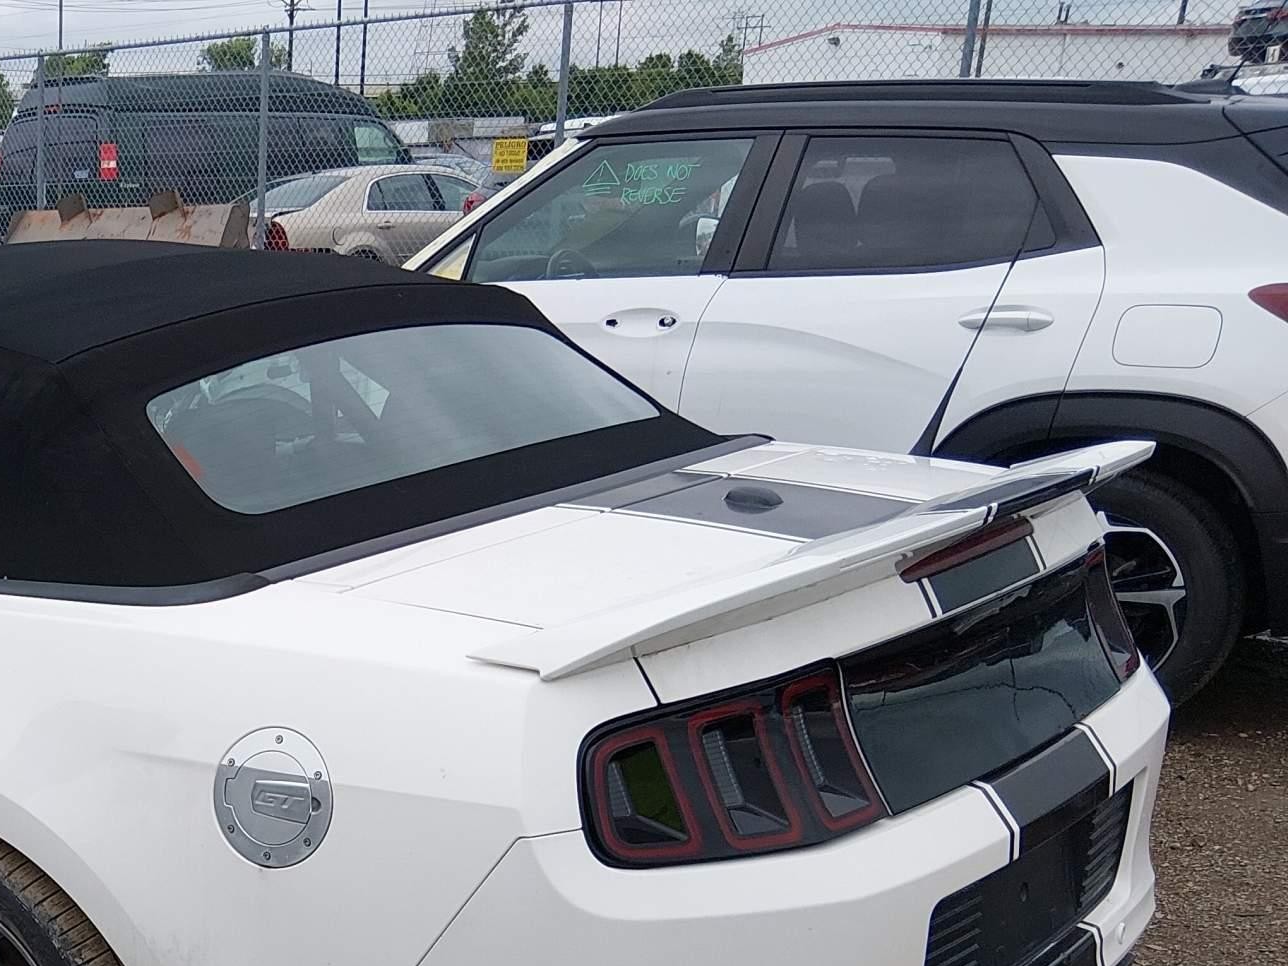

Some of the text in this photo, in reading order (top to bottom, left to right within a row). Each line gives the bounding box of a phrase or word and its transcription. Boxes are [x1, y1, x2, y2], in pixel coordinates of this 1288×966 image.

[624, 163, 701, 184] DOES NOT
[620, 186, 688, 206] REVERSE
[254, 790, 305, 809] GT
